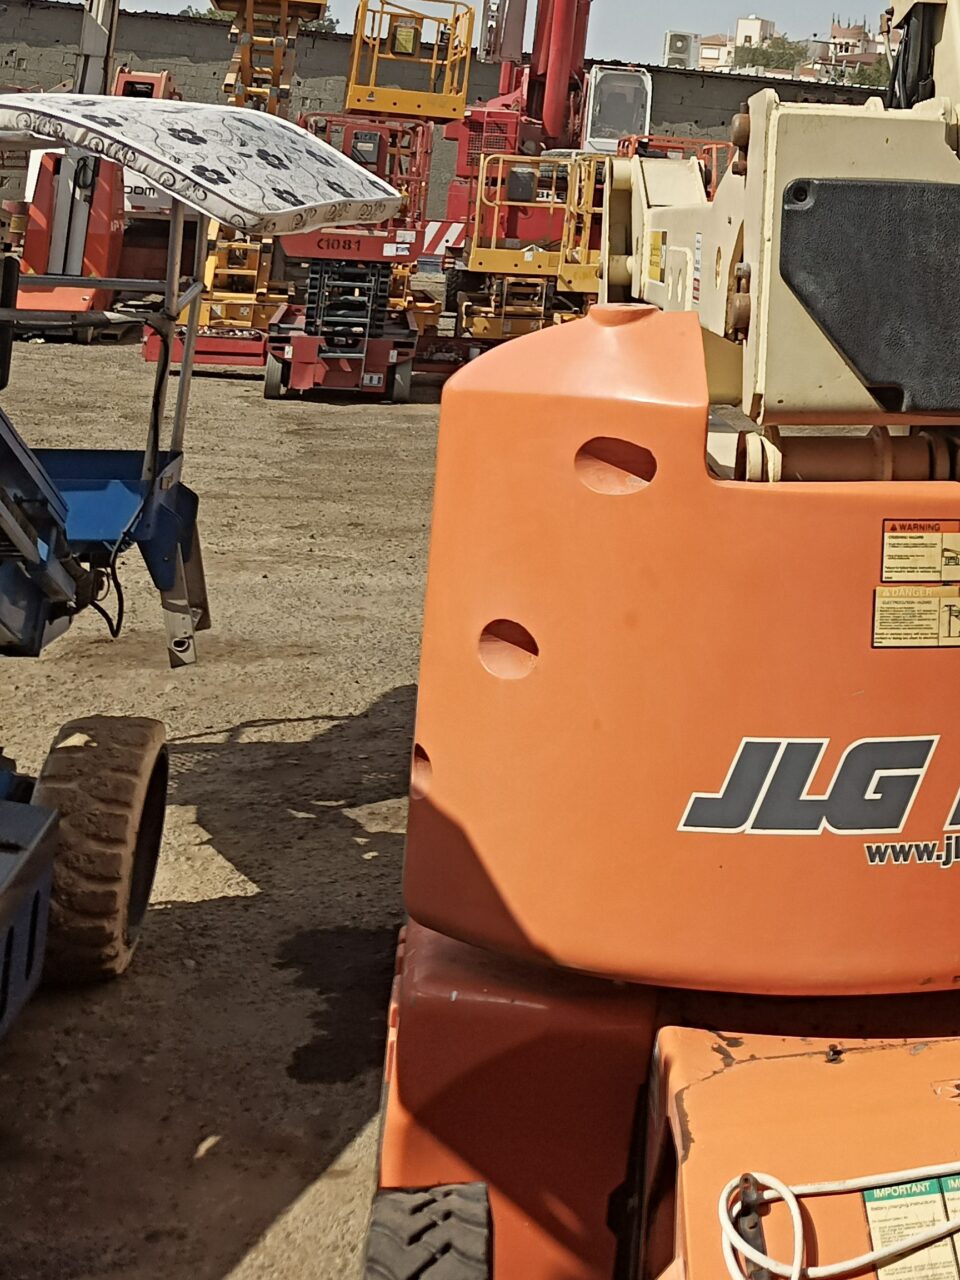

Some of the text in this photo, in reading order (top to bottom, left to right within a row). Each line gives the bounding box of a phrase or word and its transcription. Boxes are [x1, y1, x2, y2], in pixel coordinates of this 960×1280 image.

[899, 523, 941, 532] WARNING
[892, 587, 933, 597] DANGER
[676, 733, 941, 836] JLG
[873, 1182, 931, 1198] IMPORTANT
